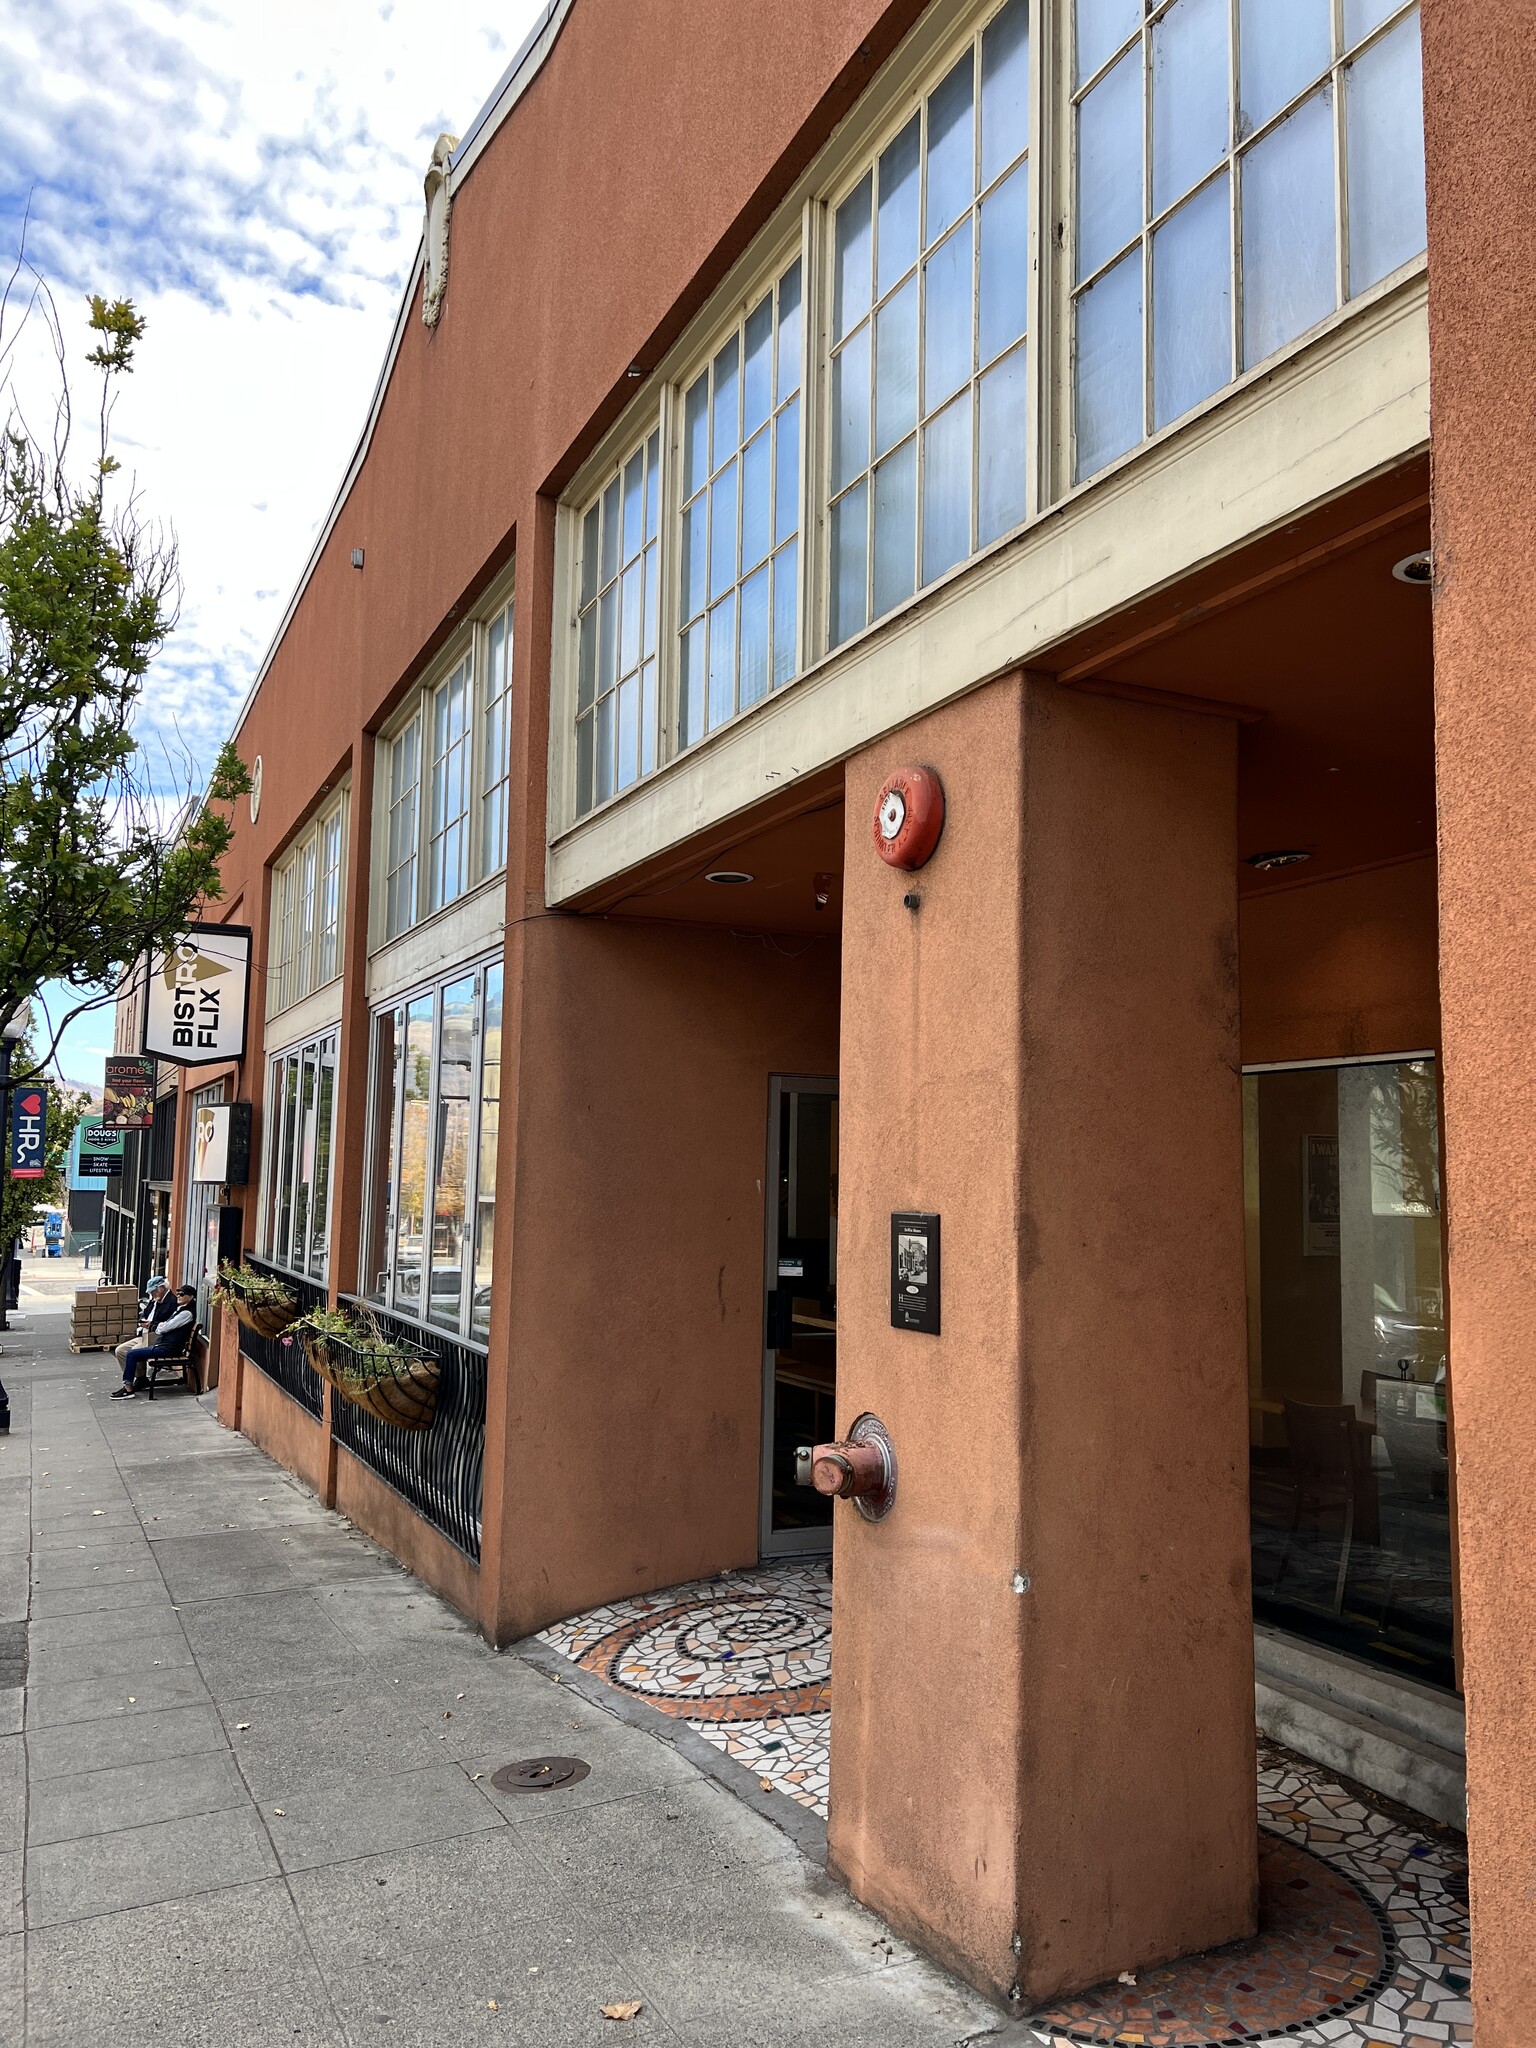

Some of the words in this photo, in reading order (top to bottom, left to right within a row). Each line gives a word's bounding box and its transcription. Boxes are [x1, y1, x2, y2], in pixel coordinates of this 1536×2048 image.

[173, 942, 198, 1047] BISTRO
[197, 987, 220, 1048] FLIX
[106, 1066, 145, 1074] arome
[17, 1116, 41, 1164] HR
